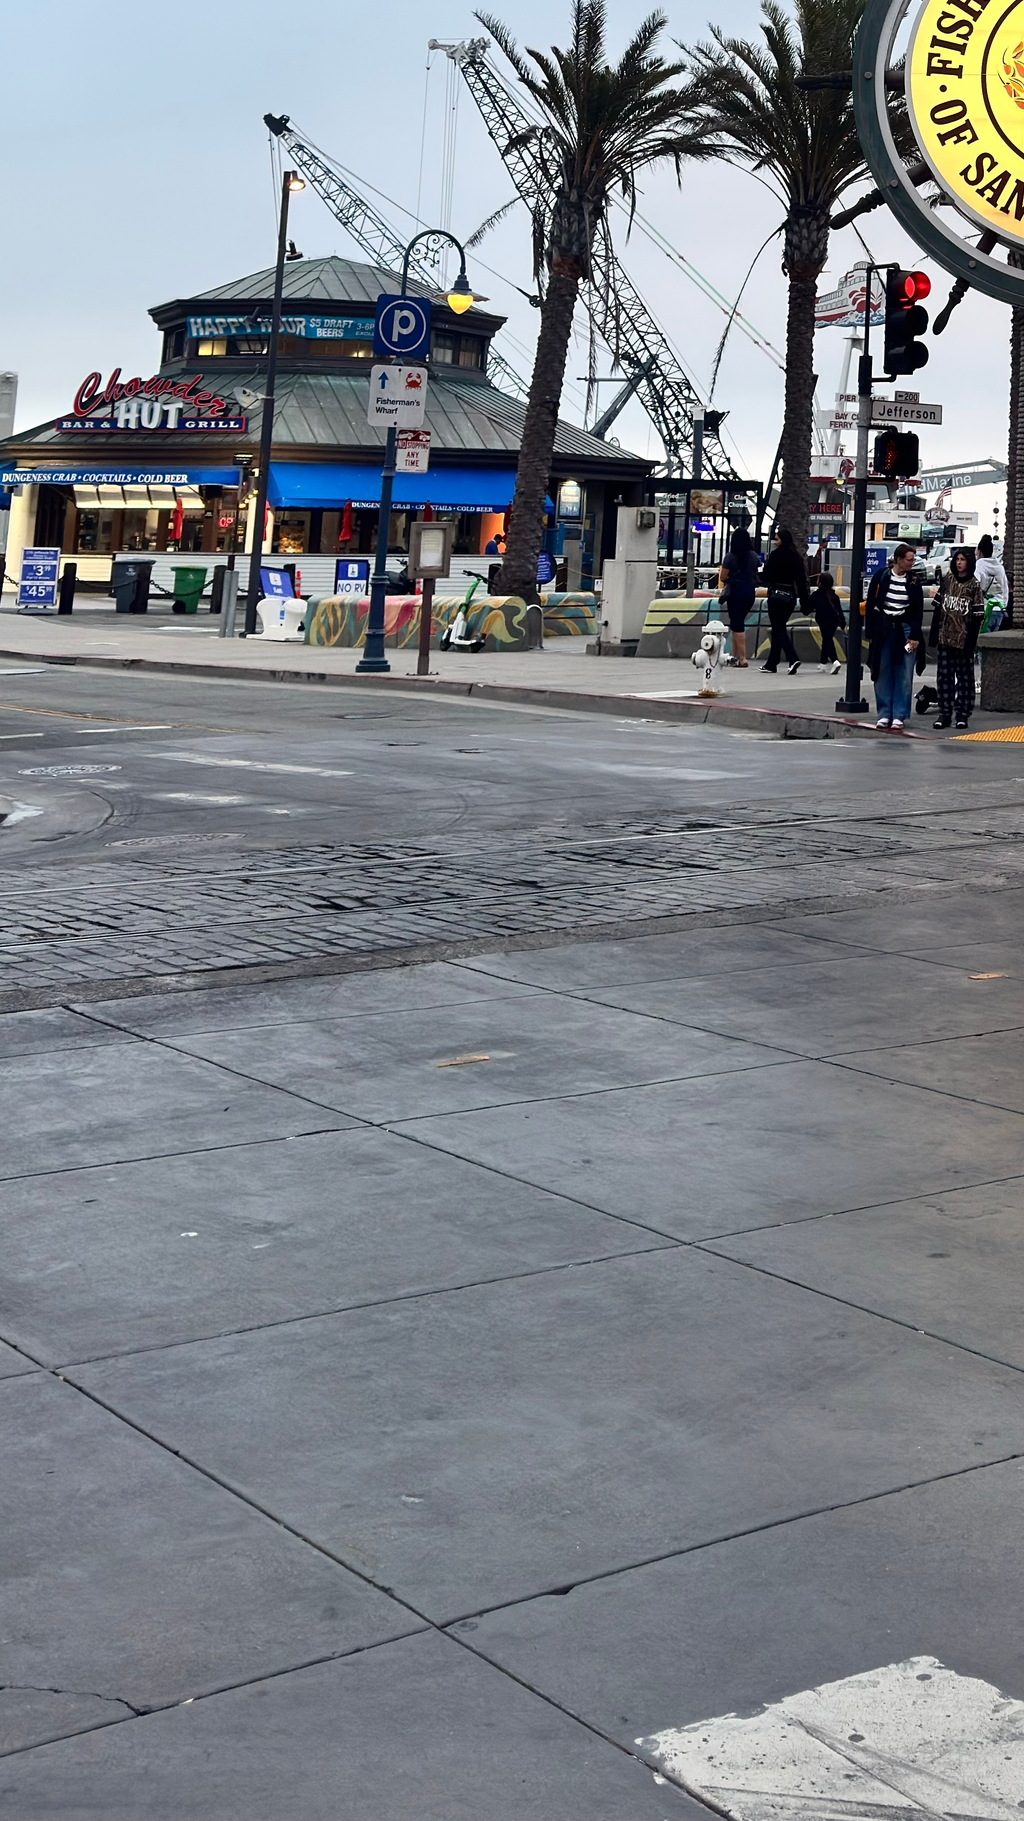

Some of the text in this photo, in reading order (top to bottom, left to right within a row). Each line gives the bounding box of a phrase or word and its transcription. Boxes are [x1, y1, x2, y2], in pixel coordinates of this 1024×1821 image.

[929, 99, 977, 147] OF
[190, 317, 252, 336] HAPPY
[309, 318, 354, 329] $5 DRAFT
[316, 327, 344, 338] BEERS
[73, 367, 227, 417] Chowder
[376, 397, 420, 407] Fisherman's
[839, 394, 857, 402] PIER
[904, 393, 918, 402] 200
[375, 406, 399, 415] Wharf
[878, 404, 936, 420] Jefferson
[116, 402, 184, 430] HUT
[835, 412, 848, 420] BAY
[62, 421, 240, 429] BAR & GRILL
[829, 420, 853, 429] FERRY
[407, 441, 429, 450] STOPPING
[406, 451, 420, 459] ANY
[404, 459, 420, 467] TIME
[2, 473, 188, 483] DUNGENESS CRAB COCKTAILS COLD BEER
[819, 504, 841, 513] HERE
[866, 550, 877, 558] Just
[866, 558, 879, 566] drive
[866, 565, 872, 573] in
[337, 582, 366, 594] NO RV
[705, 667, 712, 680] 8
